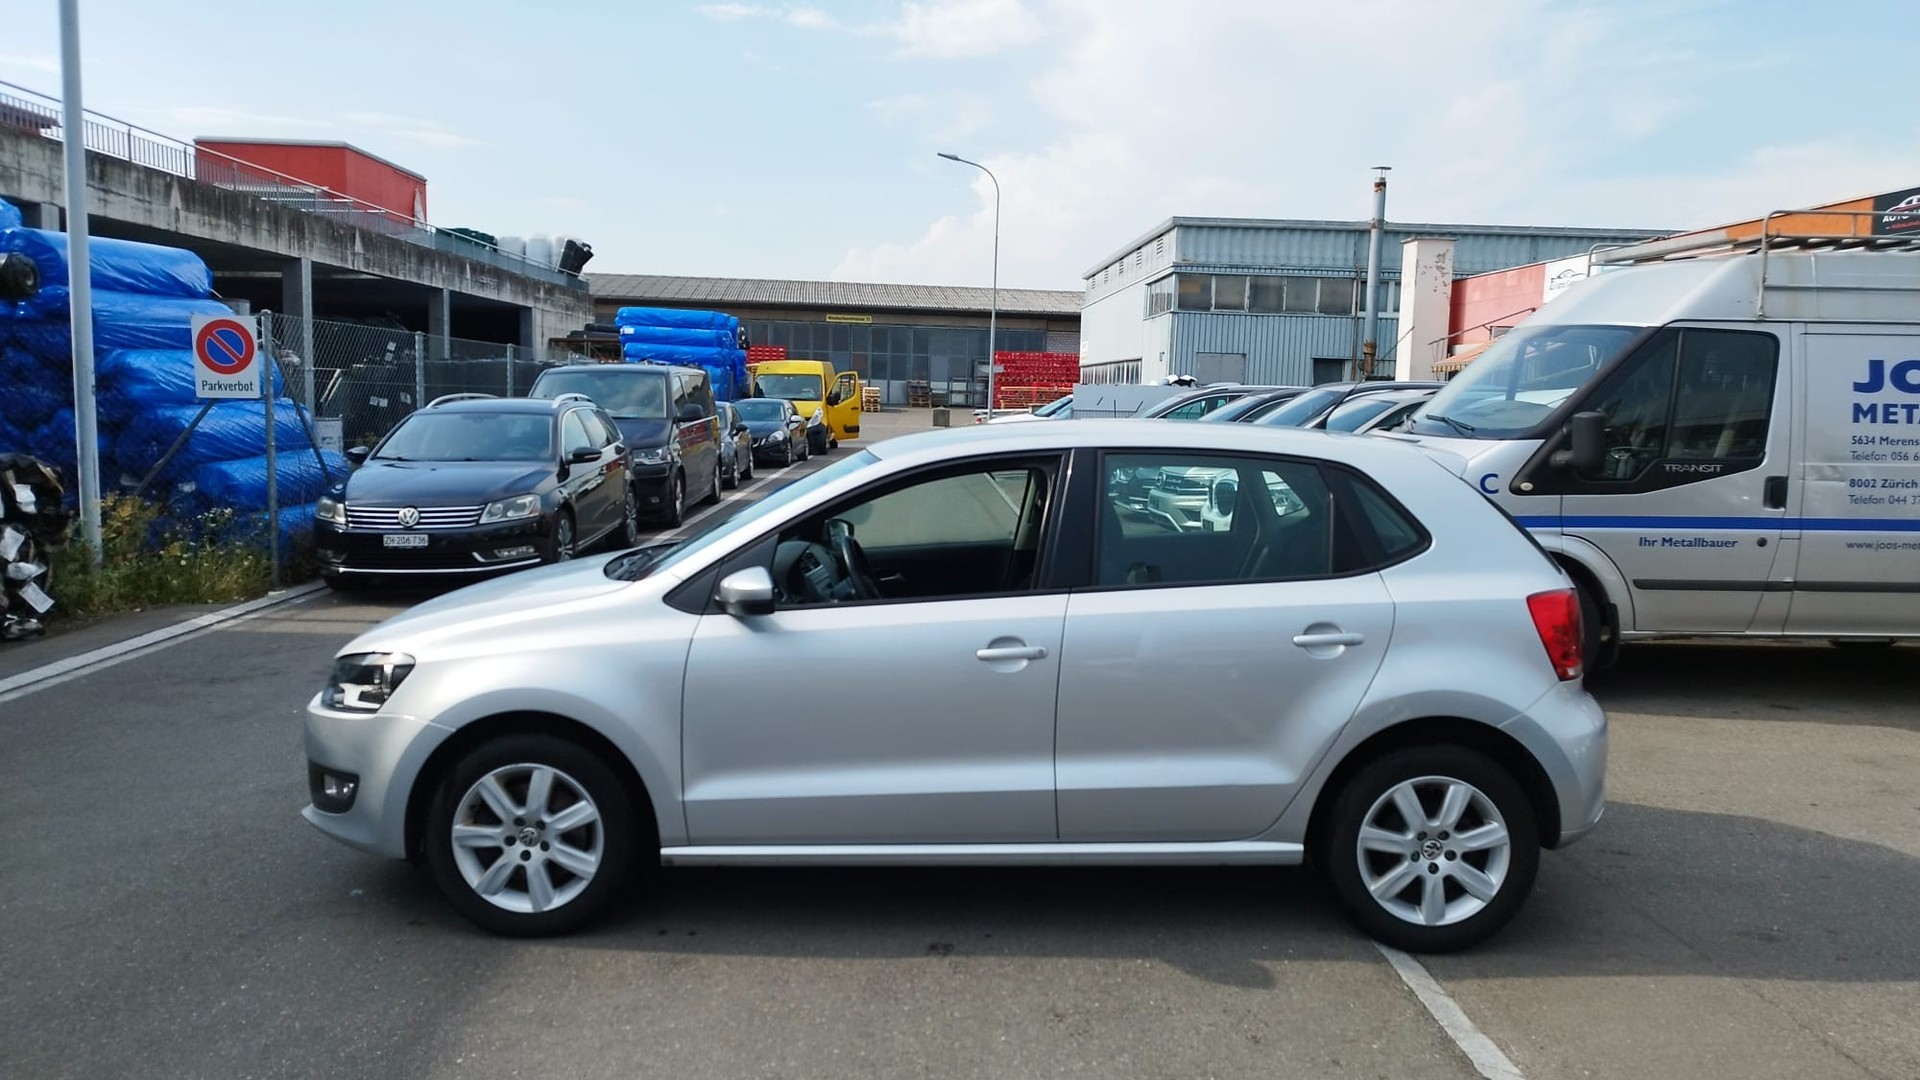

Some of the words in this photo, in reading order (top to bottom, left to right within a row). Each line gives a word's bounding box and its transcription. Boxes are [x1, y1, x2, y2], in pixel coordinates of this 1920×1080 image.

[202, 380, 254, 392] Parkverbot
[1852, 402, 1920, 424] MET
[1851, 435, 1876, 446] 5634
[1850, 450, 1888, 461] Telefon
[1890, 451, 1909, 462] 056
[1912, 453, 1920, 462] 6
[1663, 464, 1724, 473] TRANSIT
[1849, 479, 1877, 489] 8002
[1880, 479, 1918, 489] Zürich
[1847, 494, 1885, 505] Telefon
[1888, 495, 1907, 505] 044
[1638, 536, 1658, 547] Ihr
[1661, 536, 1738, 548] Metallbauer
[1845, 541, 1920, 552] www.joos-me
